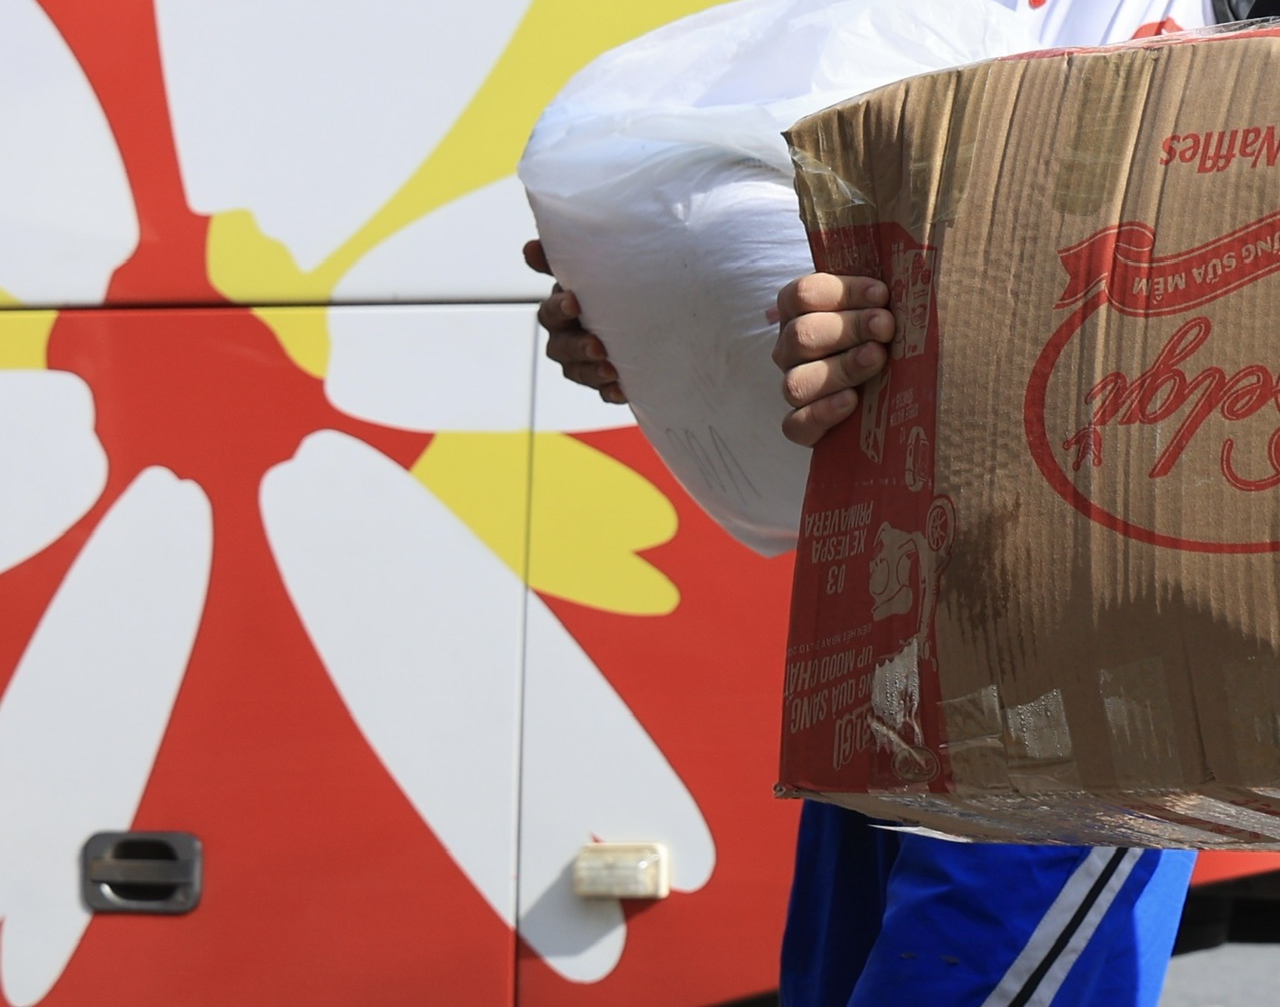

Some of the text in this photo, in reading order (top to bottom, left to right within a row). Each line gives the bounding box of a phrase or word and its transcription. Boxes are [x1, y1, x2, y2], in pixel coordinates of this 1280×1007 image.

[1132, 265, 1187, 304] MỀM
[1192, 252, 1237, 285] SỮA
[811, 528, 866, 563] XE VESPA
[826, 564, 846, 595] 03
[820, 649, 855, 681] MOOD
[857, 645, 872, 667] UP
[790, 691, 829, 733] SANG
[831, 678, 856, 719] QUÀ
